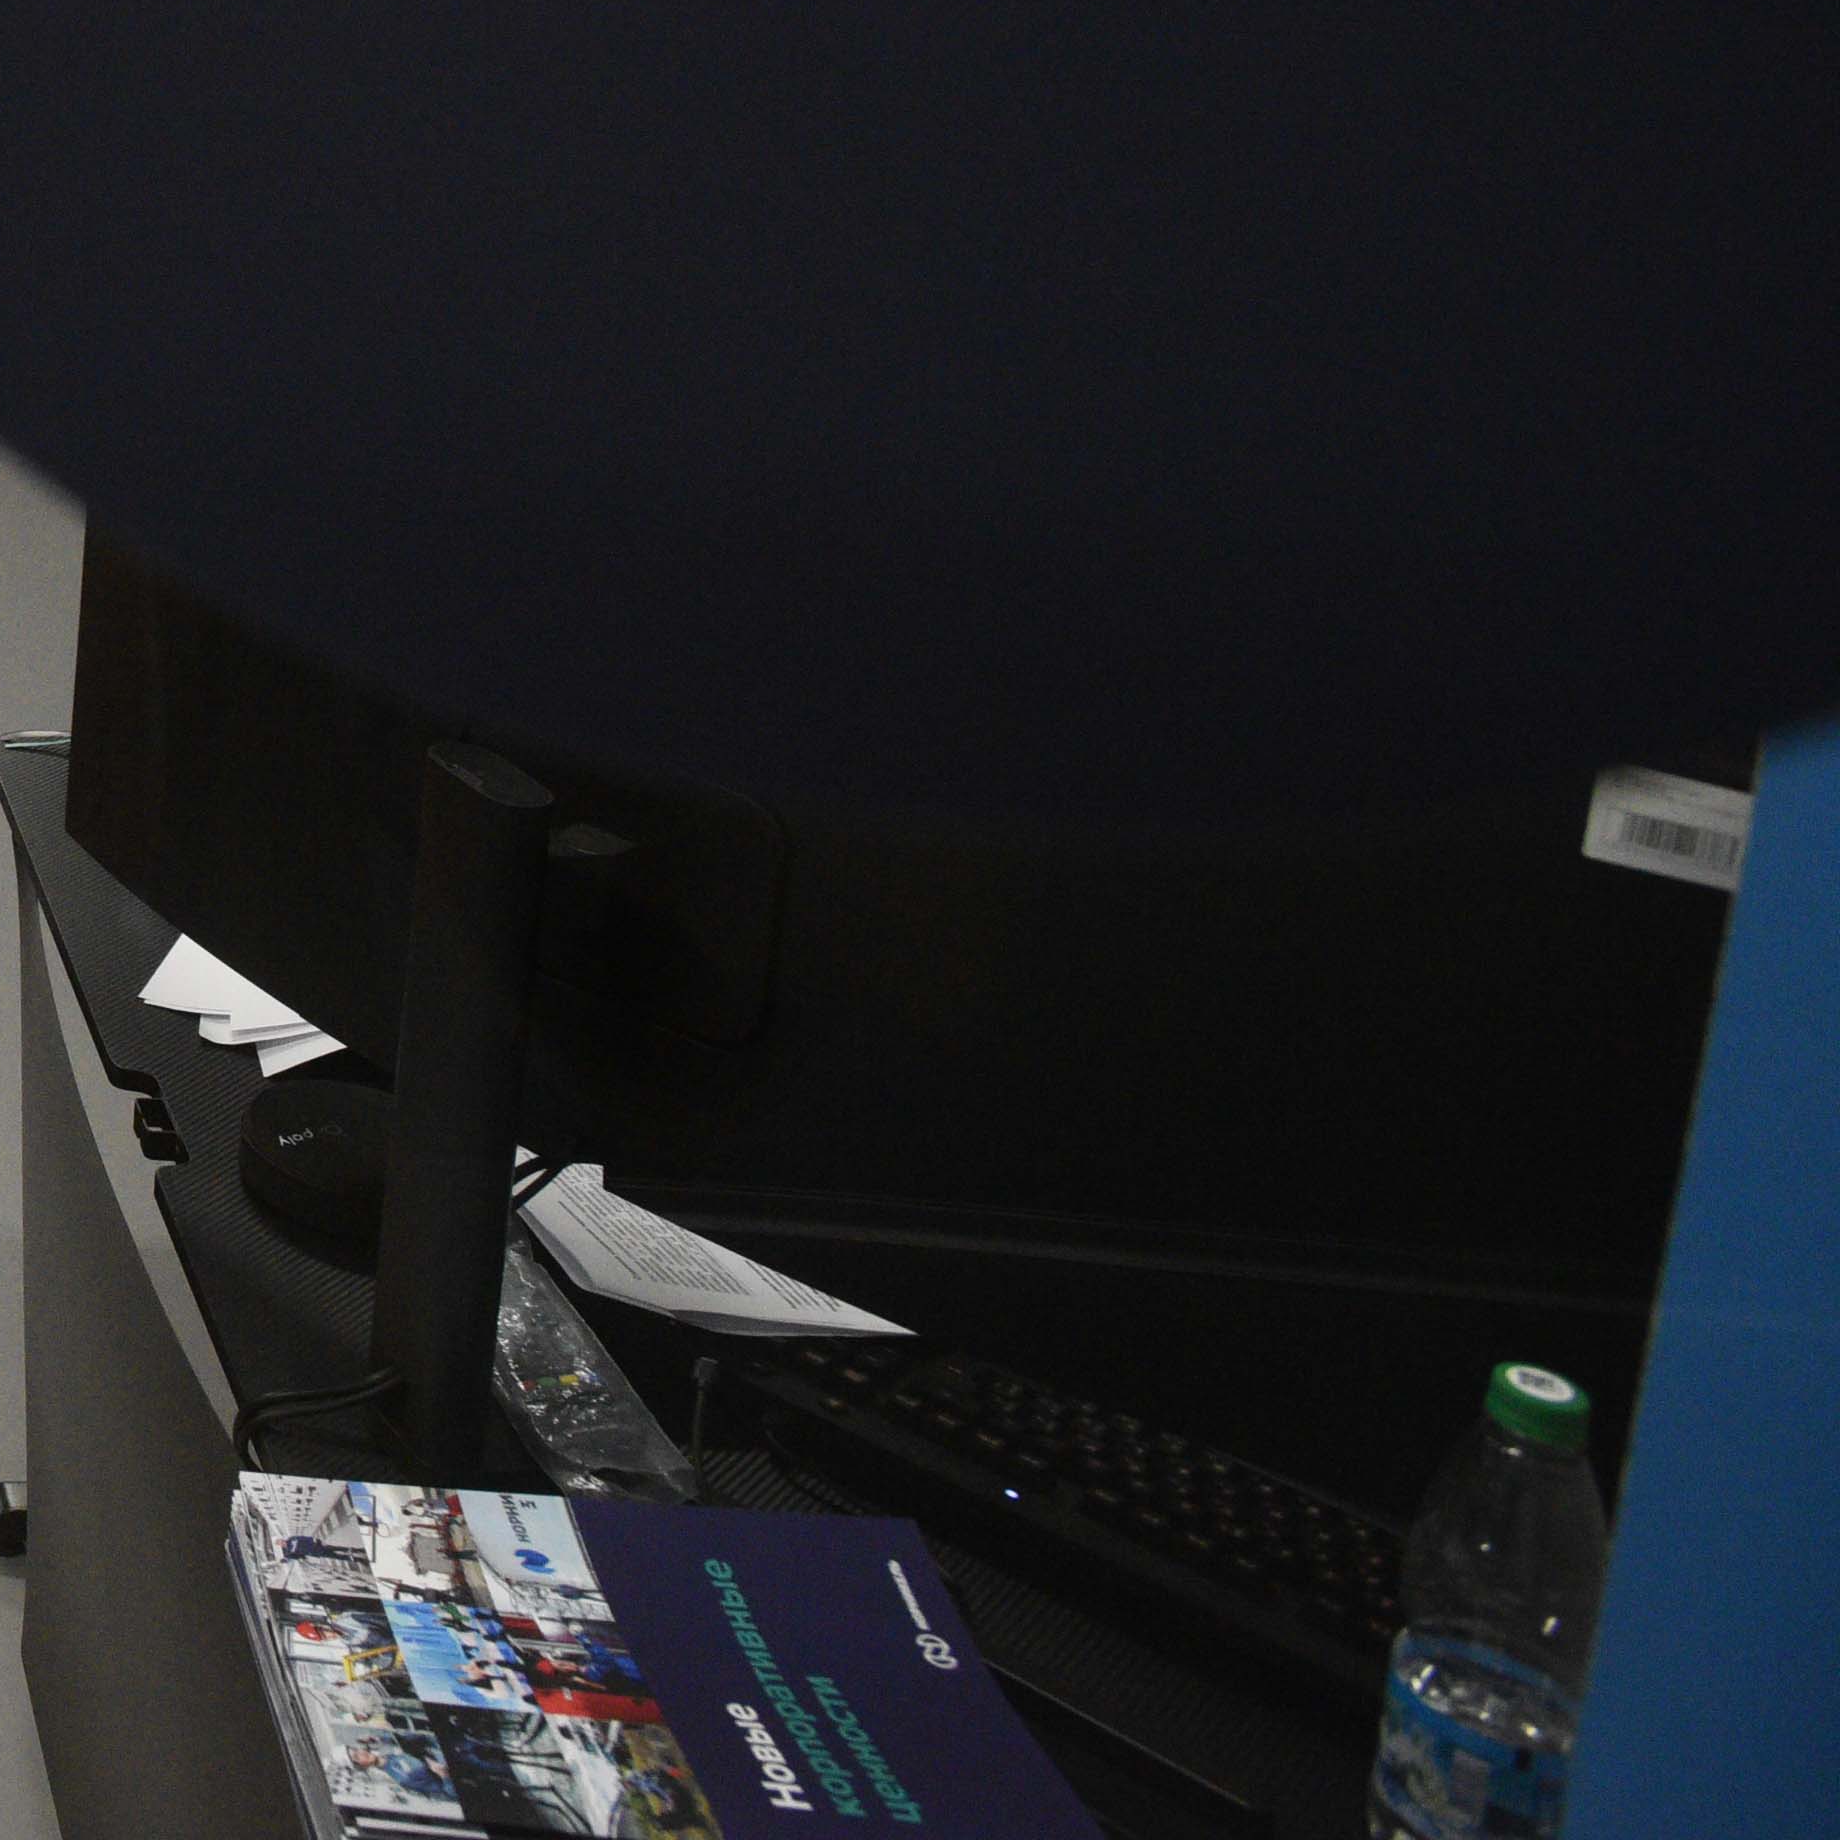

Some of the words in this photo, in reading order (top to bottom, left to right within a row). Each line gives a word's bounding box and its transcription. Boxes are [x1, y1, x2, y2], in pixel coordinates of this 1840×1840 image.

[278, 1127, 314, 1147] poly
[704, 1559, 866, 1818] корпоративные
[806, 1675, 922, 1824] ценности
[726, 1703, 814, 1811] Новые
